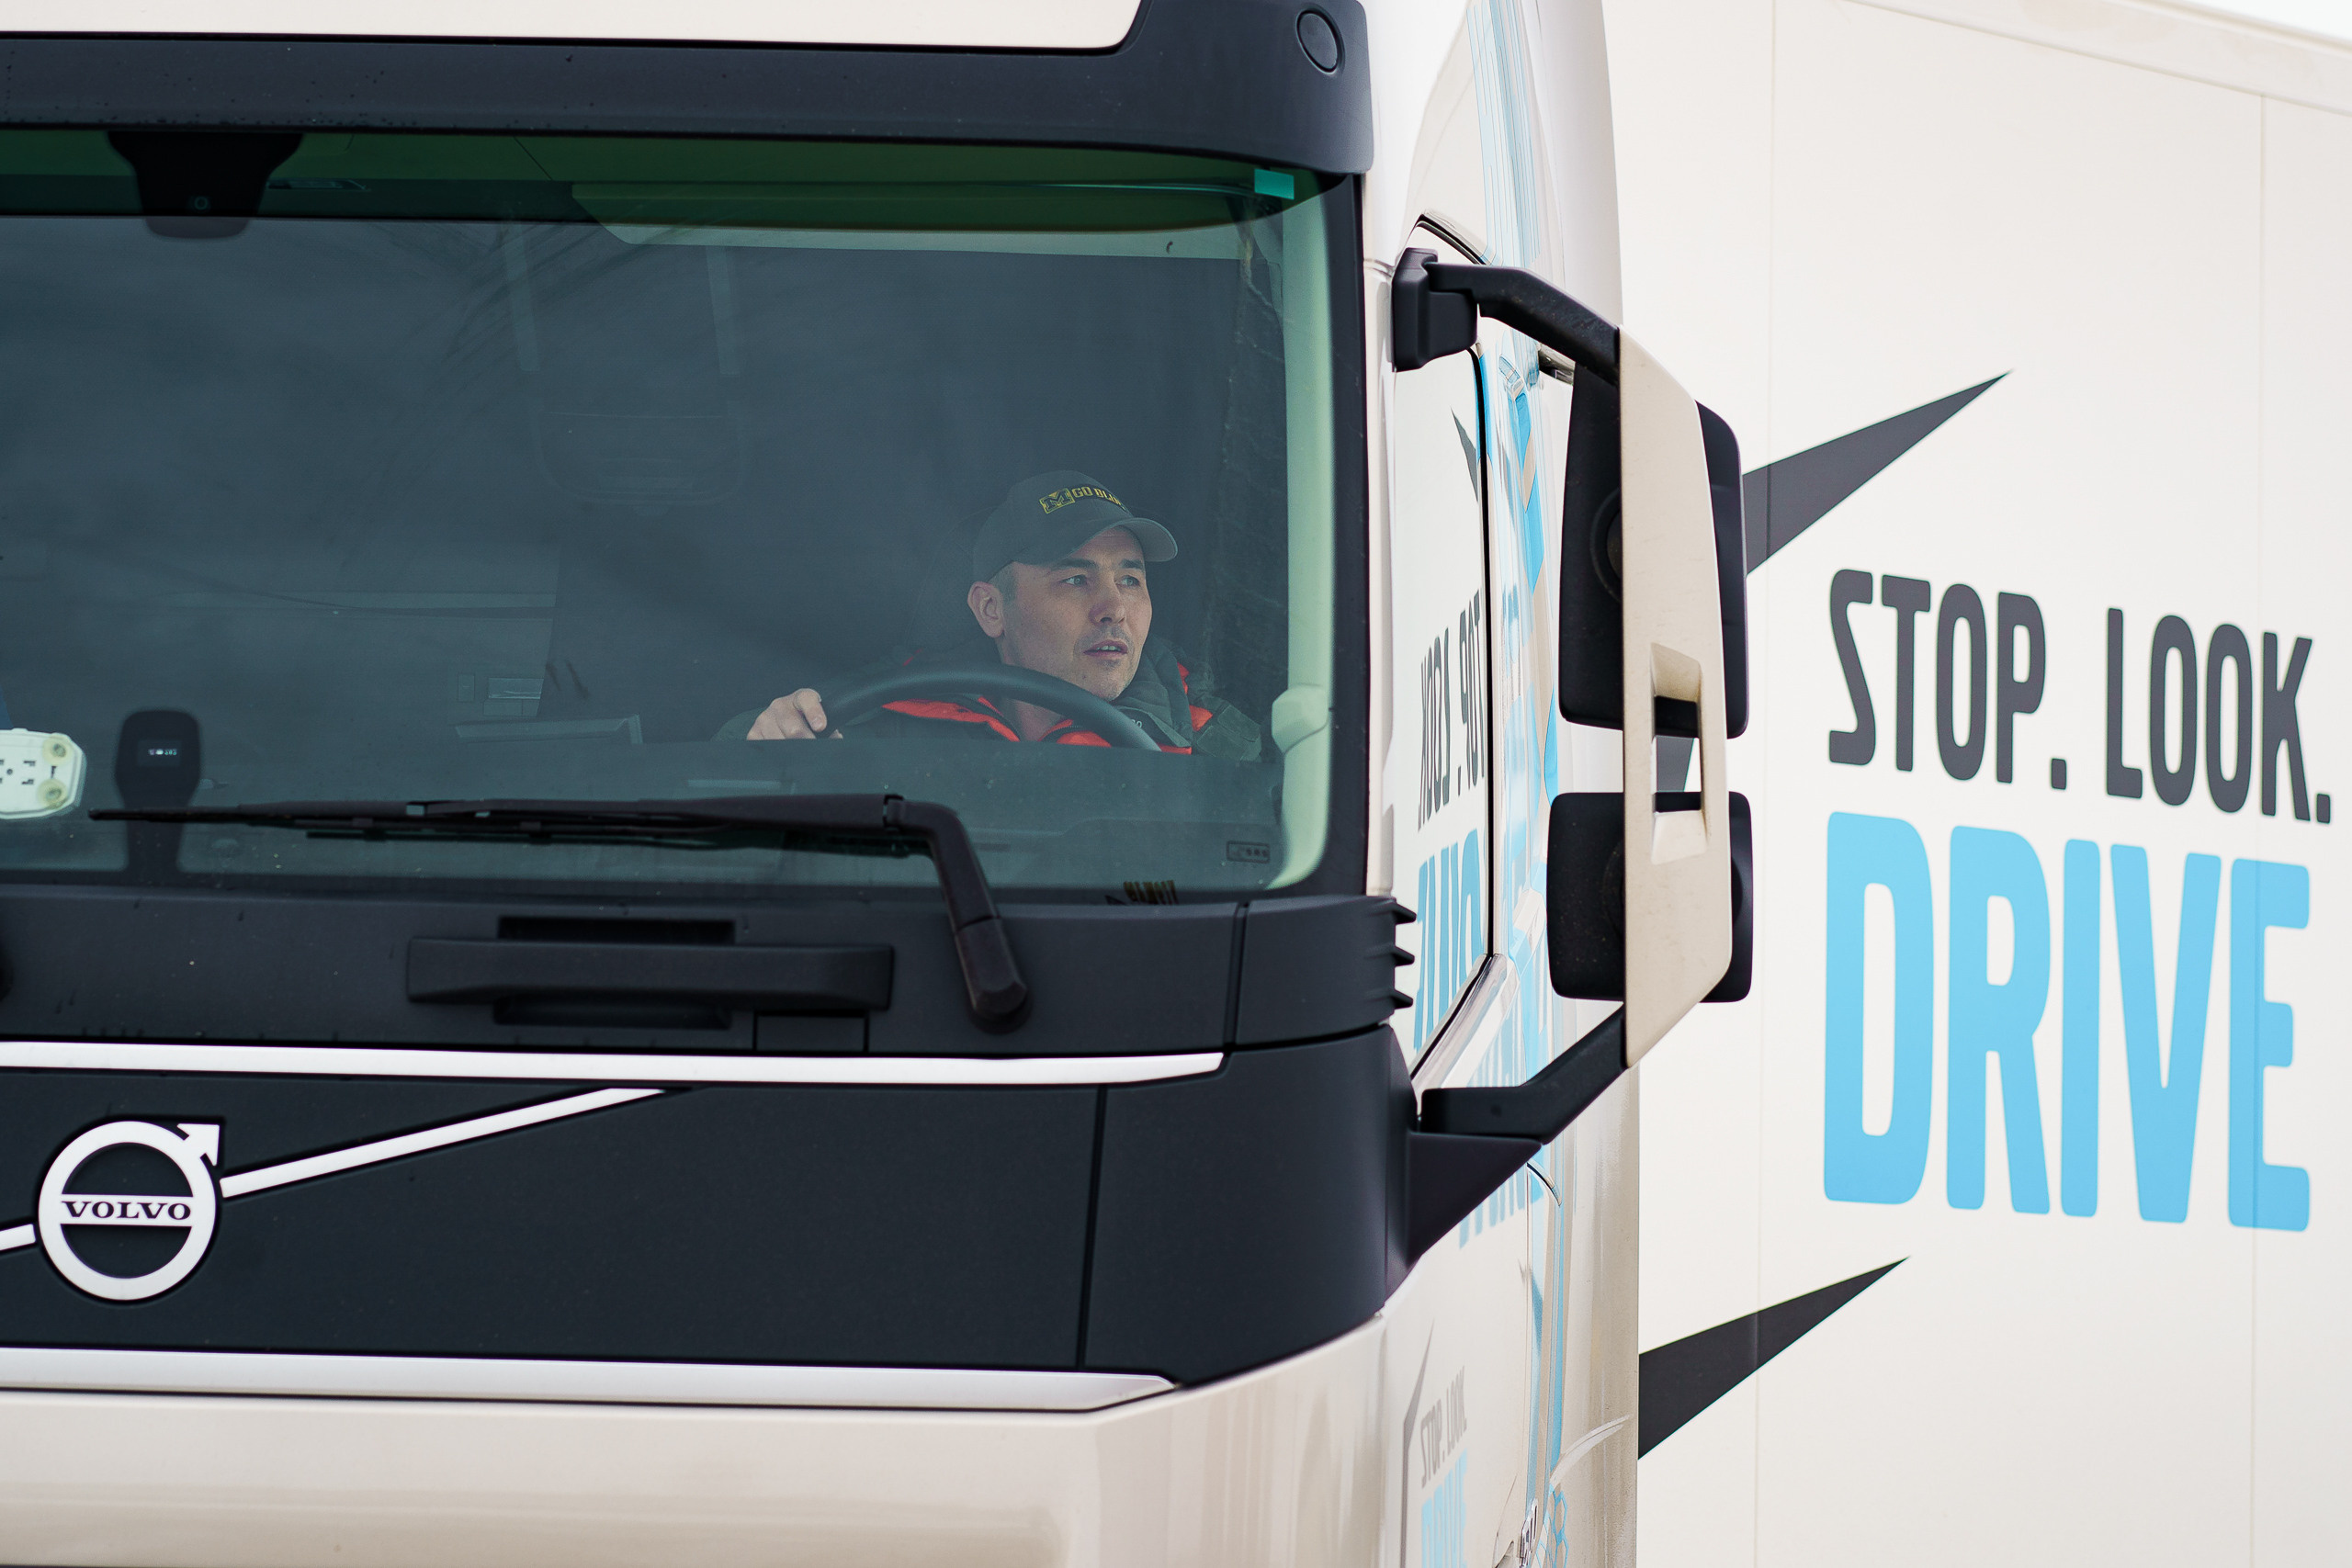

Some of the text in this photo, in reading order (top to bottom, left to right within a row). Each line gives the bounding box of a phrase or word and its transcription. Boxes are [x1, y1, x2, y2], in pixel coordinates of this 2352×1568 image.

[1071, 486, 1093, 498] GO
[1828, 568, 2332, 825] STOP. LOOK.
[1824, 810, 2311, 1233] DRIVE
[61, 1201, 192, 1221] VOLVO
